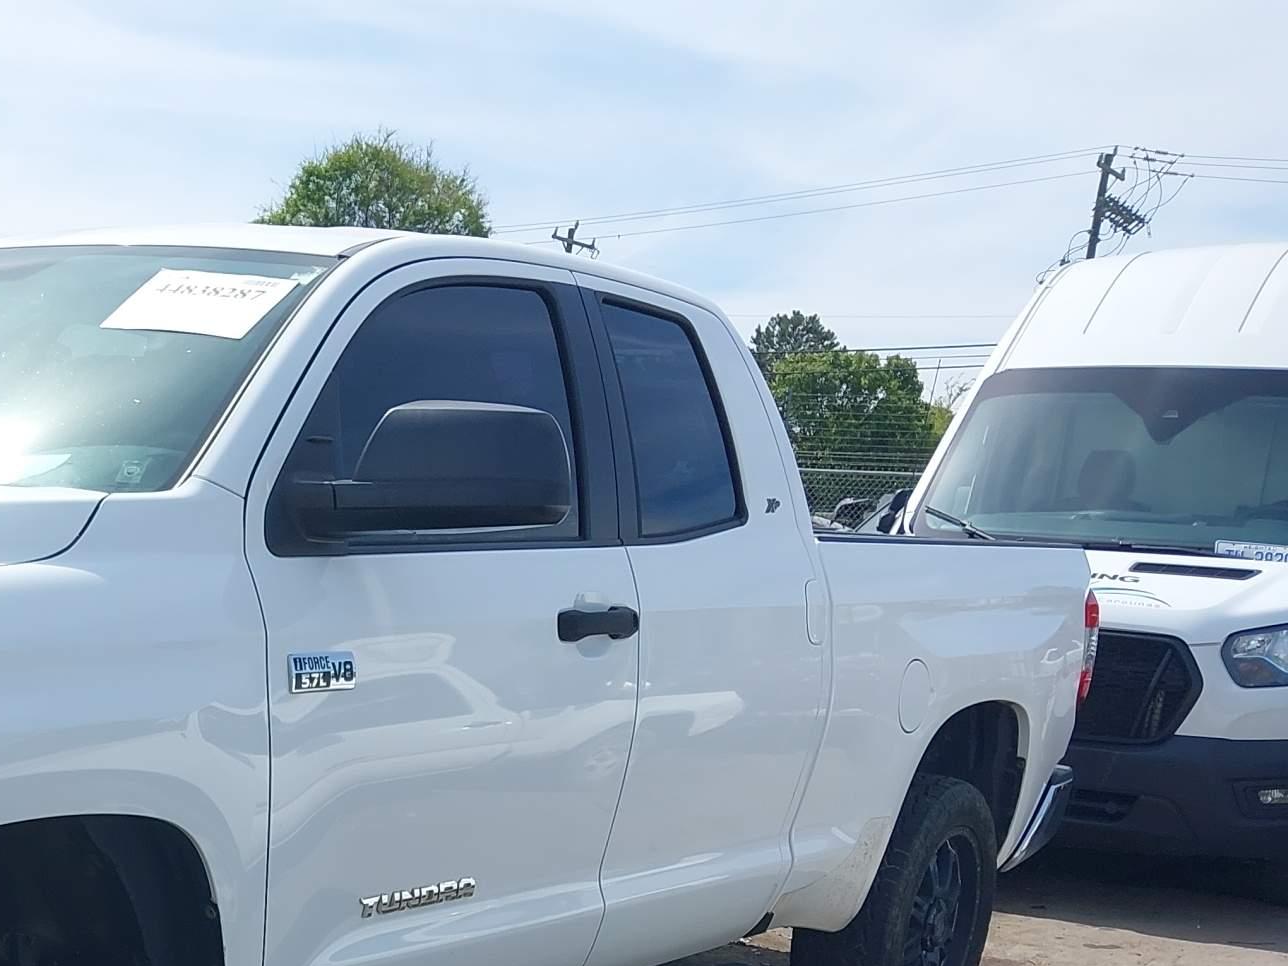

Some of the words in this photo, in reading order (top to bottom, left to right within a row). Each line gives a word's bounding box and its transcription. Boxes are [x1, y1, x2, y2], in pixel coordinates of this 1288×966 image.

[155, 282, 269, 301] 44838287
[331, 660, 354, 682] V8
[359, 876, 477, 919] TUNDRA
